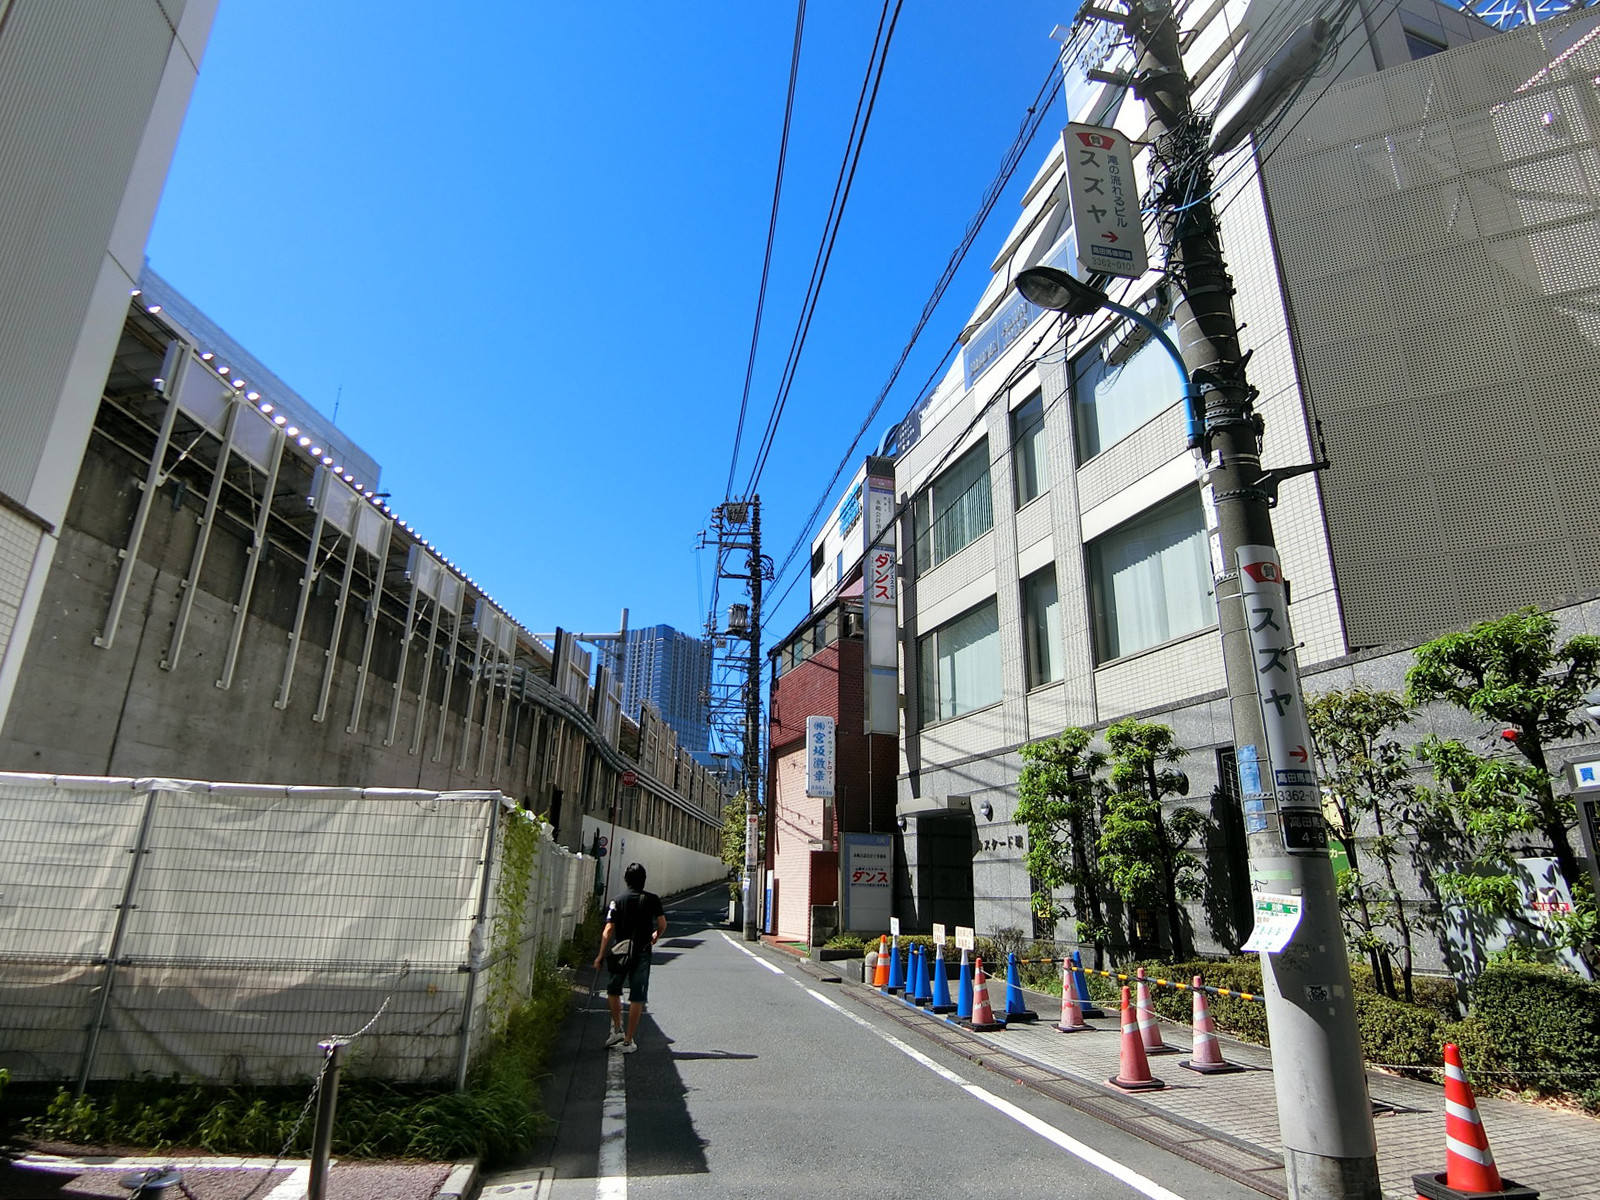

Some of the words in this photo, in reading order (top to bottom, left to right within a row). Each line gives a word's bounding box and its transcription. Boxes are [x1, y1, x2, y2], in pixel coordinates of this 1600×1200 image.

[1080, 149, 1108, 224] スズヤ
[1091, 257, 1136, 271] 3362-0101
[875, 553, 890, 600] ダンス
[1252, 608, 1292, 717] スズヤ
[852, 870, 889, 883] ダンス
